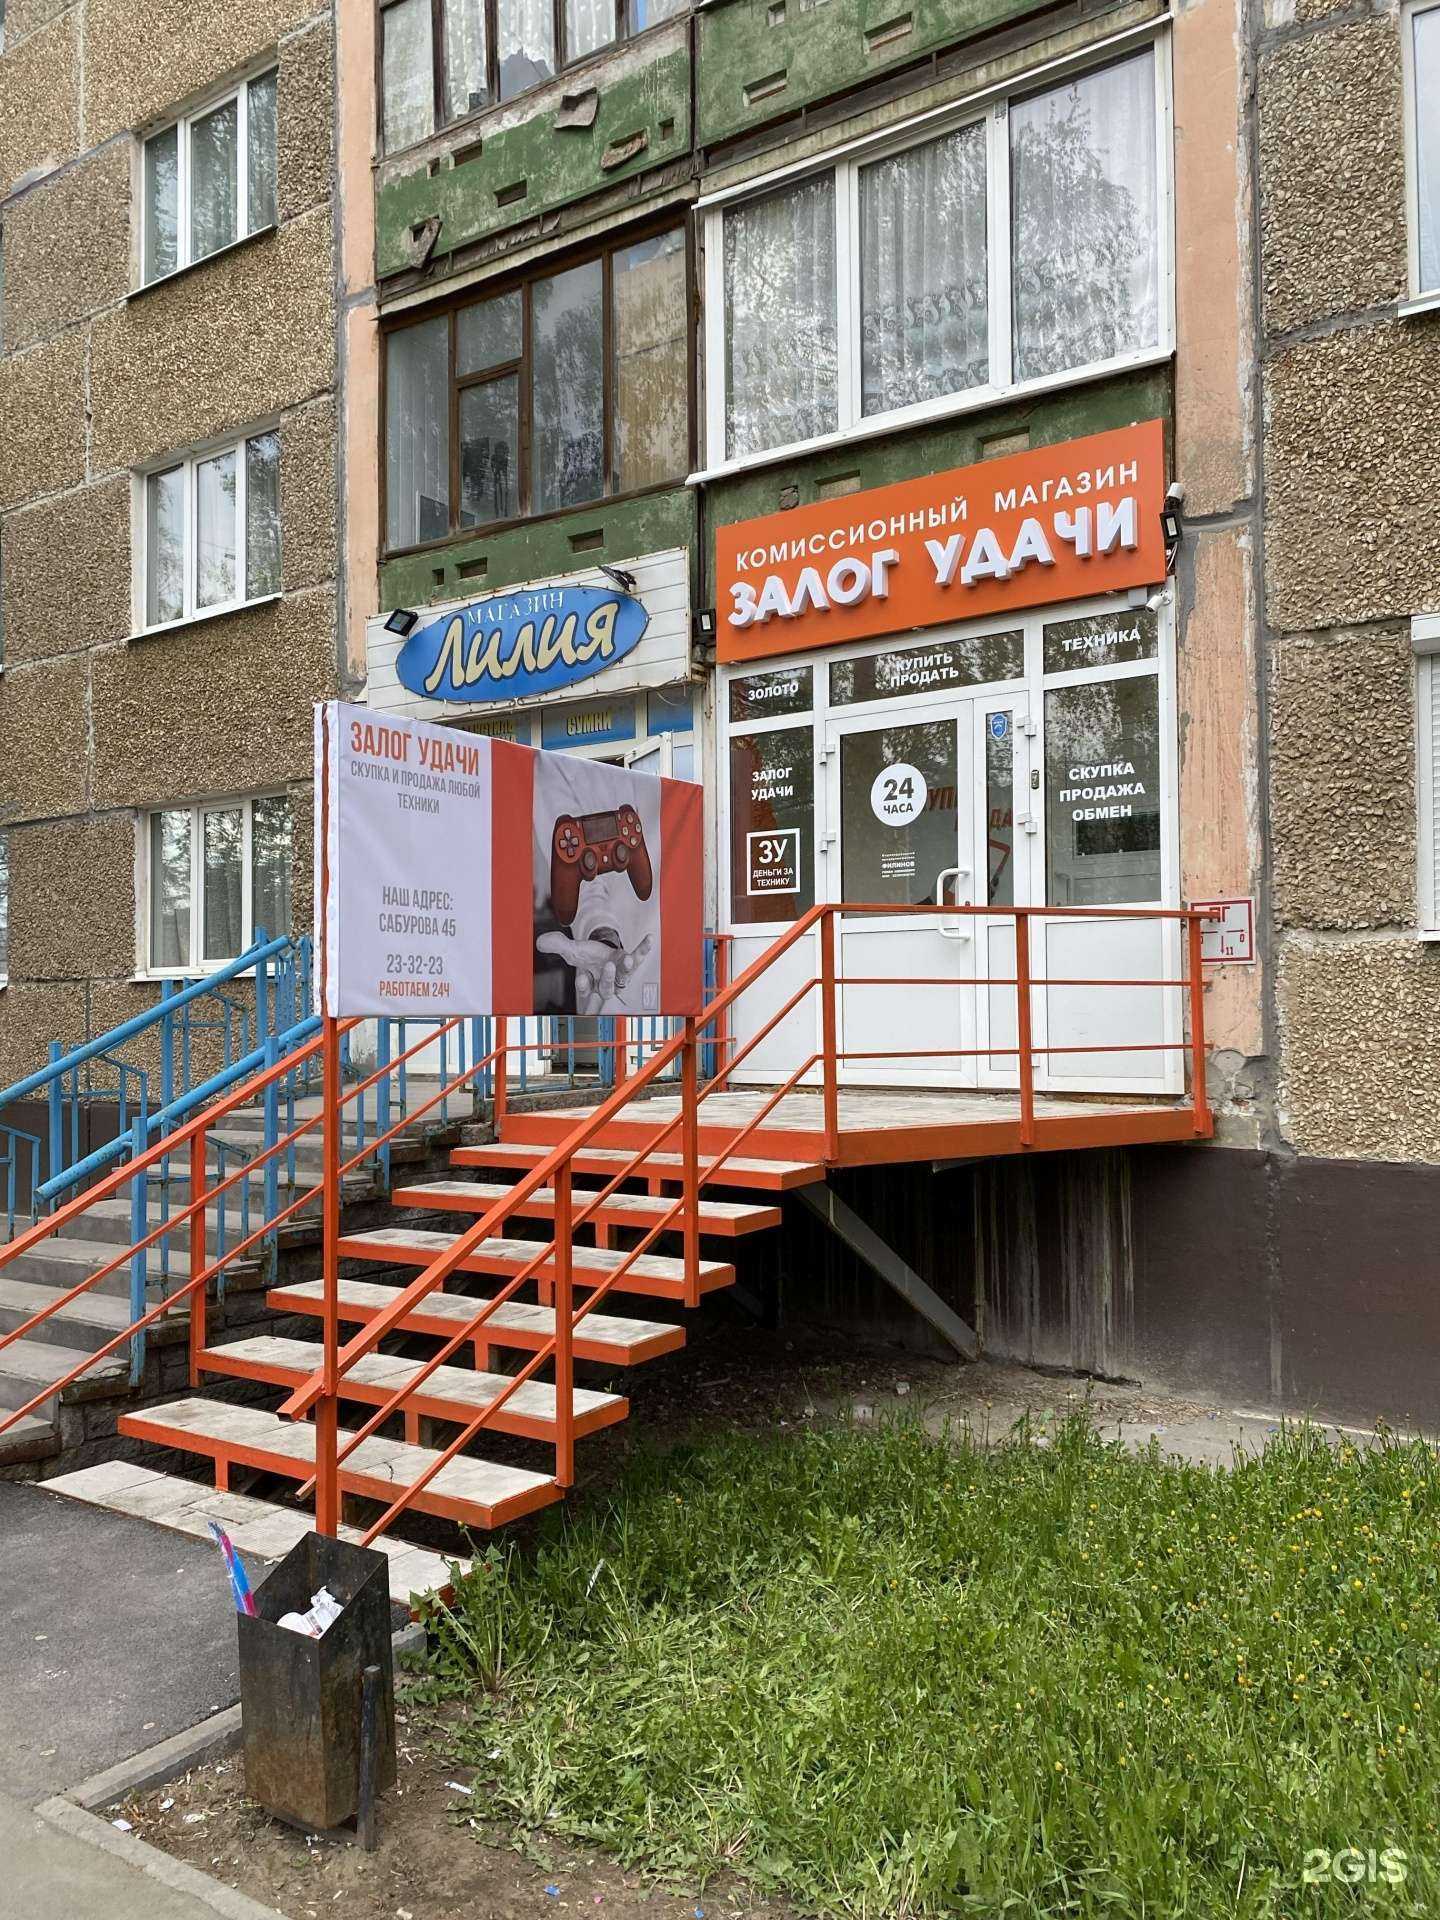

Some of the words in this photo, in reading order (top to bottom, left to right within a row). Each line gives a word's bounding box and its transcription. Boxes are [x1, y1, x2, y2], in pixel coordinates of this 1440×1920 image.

[736, 497, 968, 573] КОМИССИОННЫЙ
[994, 460, 1138, 513] МАГАЗИН
[728, 548, 900, 629] ЗАЛОГ
[925, 497, 1138, 587] УДАЧИ
[467, 591, 563, 626] МАГАЗИН
[424, 600, 620, 693] Лилия
[1062, 628, 1141, 652] ТЕХНИКА
[896, 653, 953, 671] КУПИТЬ
[890, 667, 959, 687] ПРОДАТЬ
[748, 682, 799, 701] ЗОЛОТО
[350, 721, 412, 762] ЗАЛОГ
[418, 736, 479, 776] УДАЧИ
[351, 760, 389, 781] СКУПКА
[393, 769, 399, 784] И
[401, 770, 446, 793] ПРОДАЖА
[448, 779, 481, 799] ЛЮБОЙ
[751, 767, 793, 783] ЗАЛОГ
[1069, 762, 1135, 781] СКУПКА
[751, 785, 794, 802] УДАЧИ
[883, 777, 914, 802] 24
[1059, 781, 1146, 803] ПРОДАЖА
[397, 792, 440, 814] ТЕХНИКИ
[883, 803, 914, 815] ЧАСА
[1072, 804, 1132, 821] ОБМЕН
[753, 868, 782, 878] ДЕНЬГИ
[783, 867, 794, 876] ЗА
[757, 878, 790, 887] ТЕХНИКУ
[382, 886, 409, 907] НАШ
[413, 889, 453, 911] АДРЕС:
[379, 913, 439, 936] САБУРОВА
[442, 918, 456, 937] 45
[387, 953, 444, 975] 23-32-23
[379, 980, 430, 998] РАБОТАЕМ
